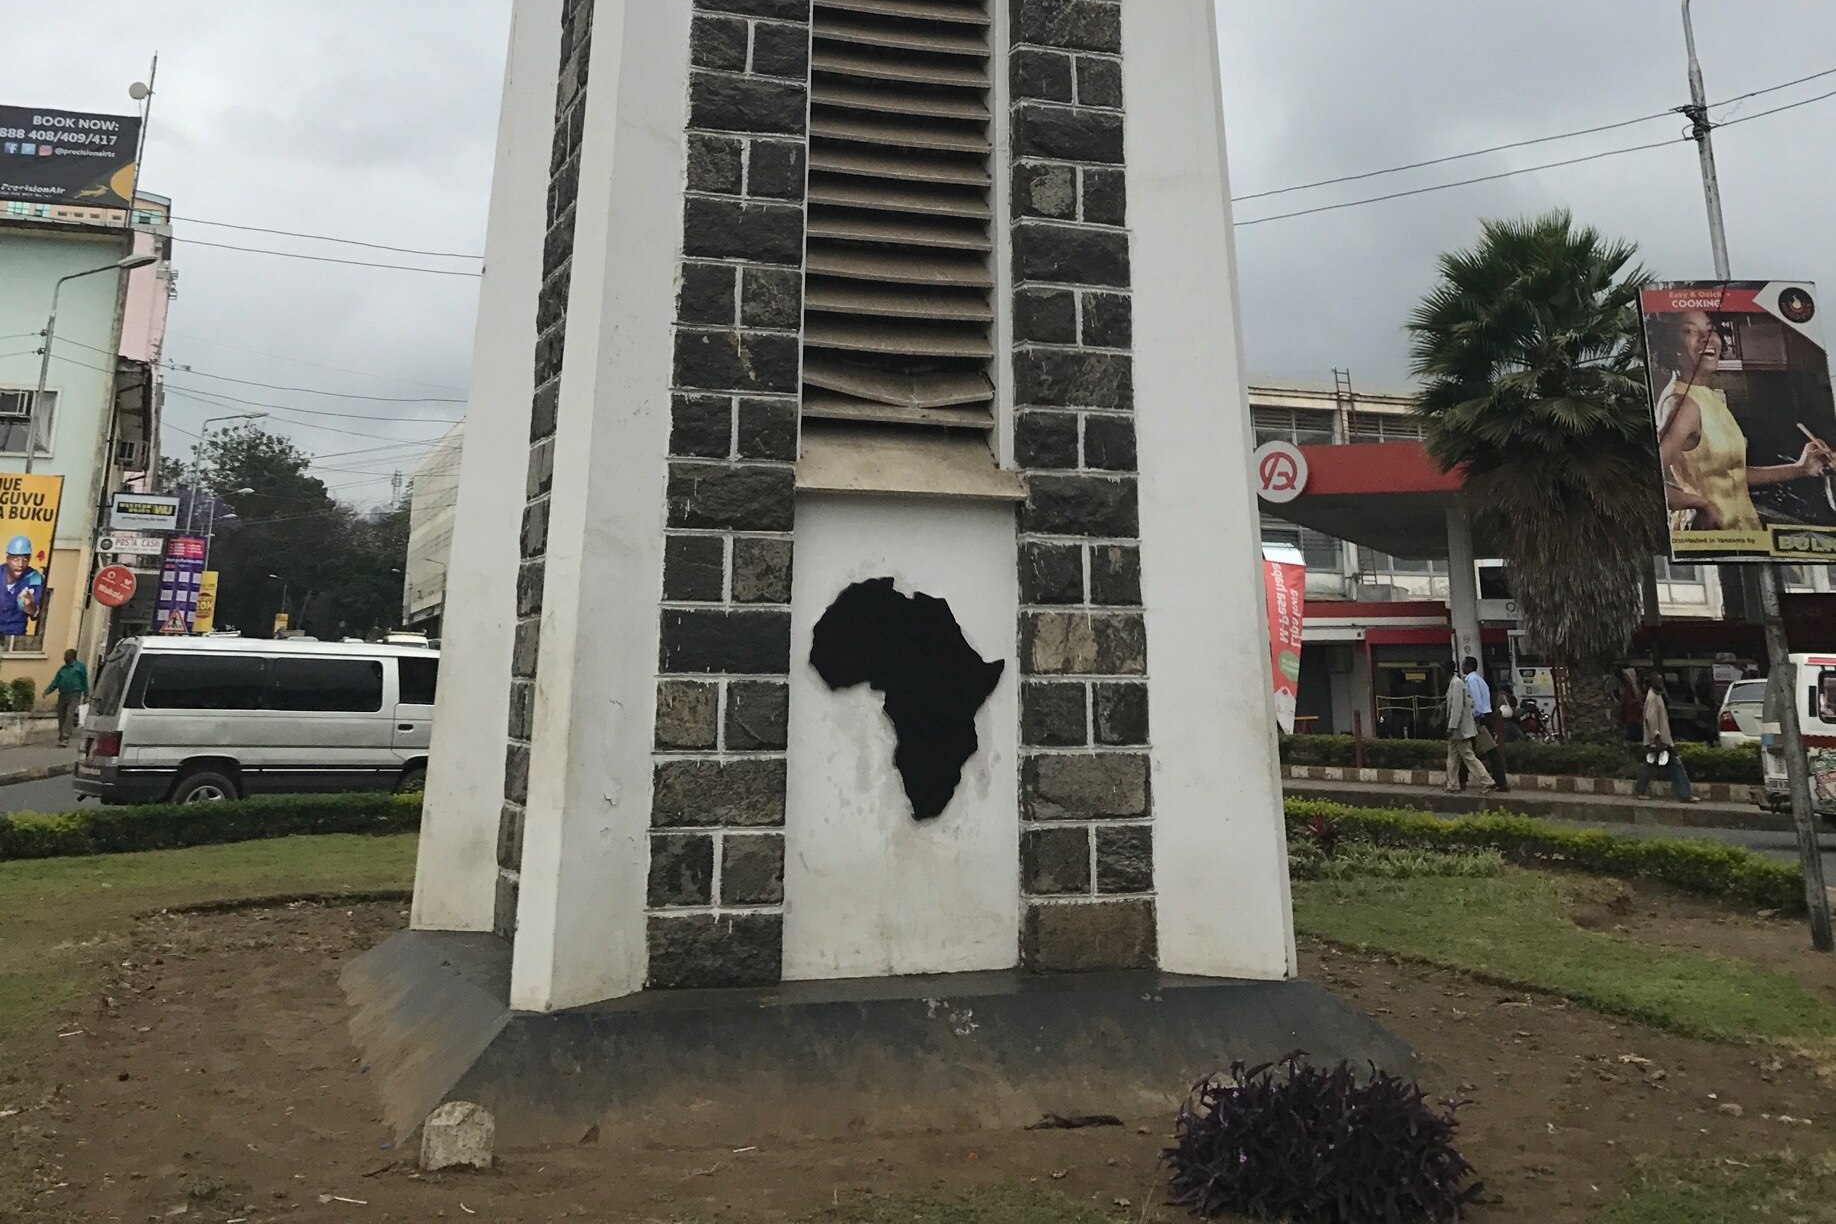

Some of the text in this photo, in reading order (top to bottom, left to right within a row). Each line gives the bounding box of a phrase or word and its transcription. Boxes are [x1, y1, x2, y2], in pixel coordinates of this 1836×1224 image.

[32, 115, 120, 132] BOOK NOW:
[28, 130, 118, 146] 408/409/417
[1671, 299, 1721, 308] COOKING
[0, 477, 23, 491] UE
[8, 506, 54, 522] BUKU
